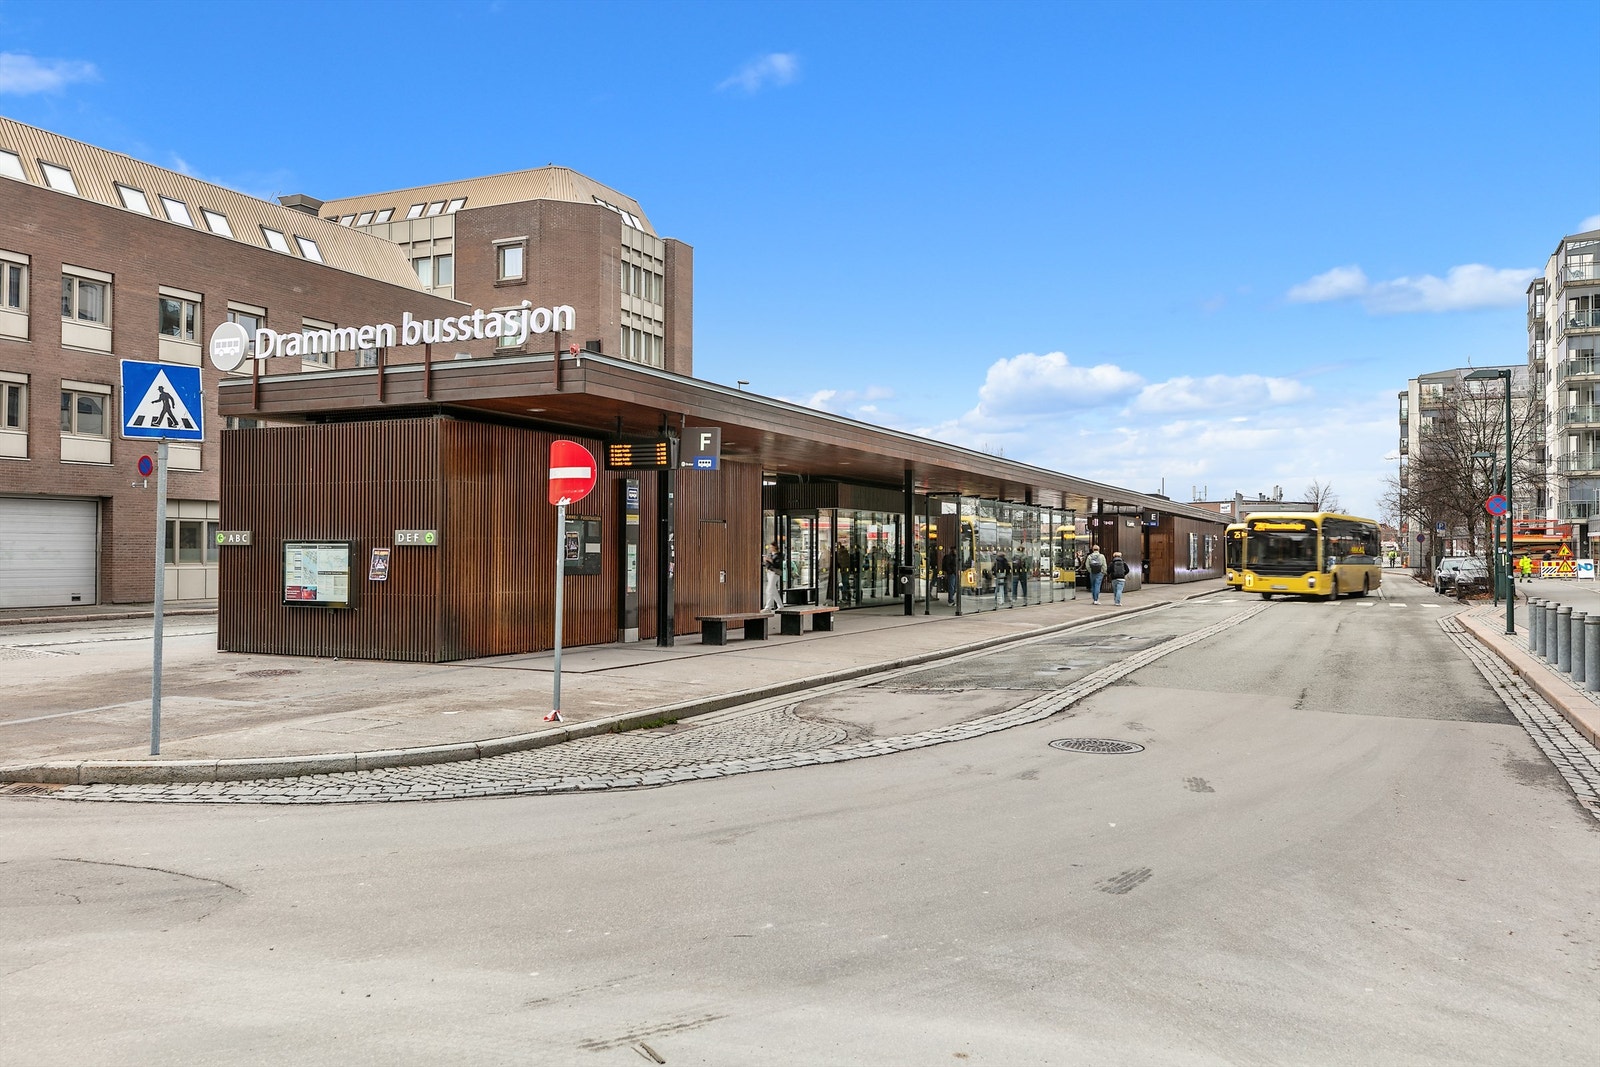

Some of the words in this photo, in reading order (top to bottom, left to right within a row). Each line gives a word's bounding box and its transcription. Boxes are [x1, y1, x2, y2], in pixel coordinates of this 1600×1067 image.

[254, 322, 396, 360] Drammen
[401, 300, 575, 346] busstasjon
[700, 432, 712, 451] F
[1151, 513, 1157, 521] E
[1233, 531, 1241, 539] 25
